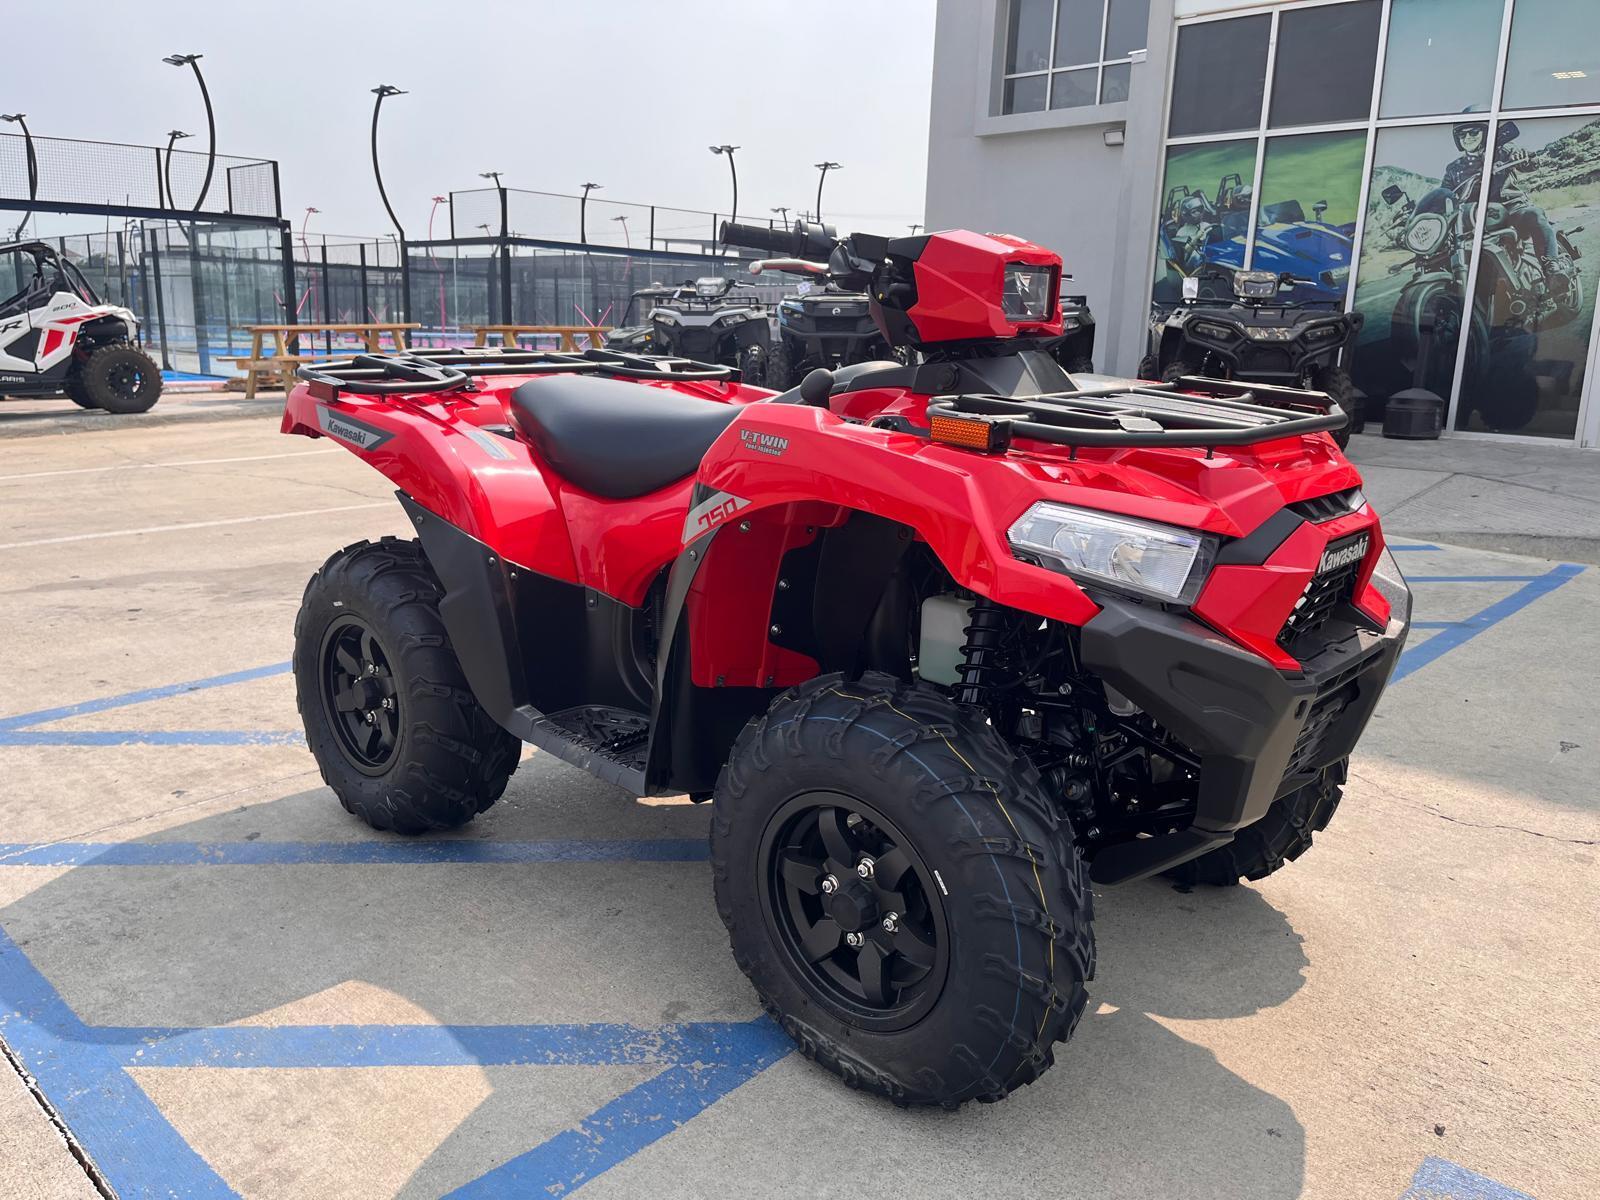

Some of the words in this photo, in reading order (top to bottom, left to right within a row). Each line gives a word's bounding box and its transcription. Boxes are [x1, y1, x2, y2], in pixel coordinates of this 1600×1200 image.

[327, 419, 367, 444] Kawasaki
[740, 429, 789, 450] V-TWIN
[697, 498, 738, 529] 750
[1318, 536, 1369, 574] Kawasaki
